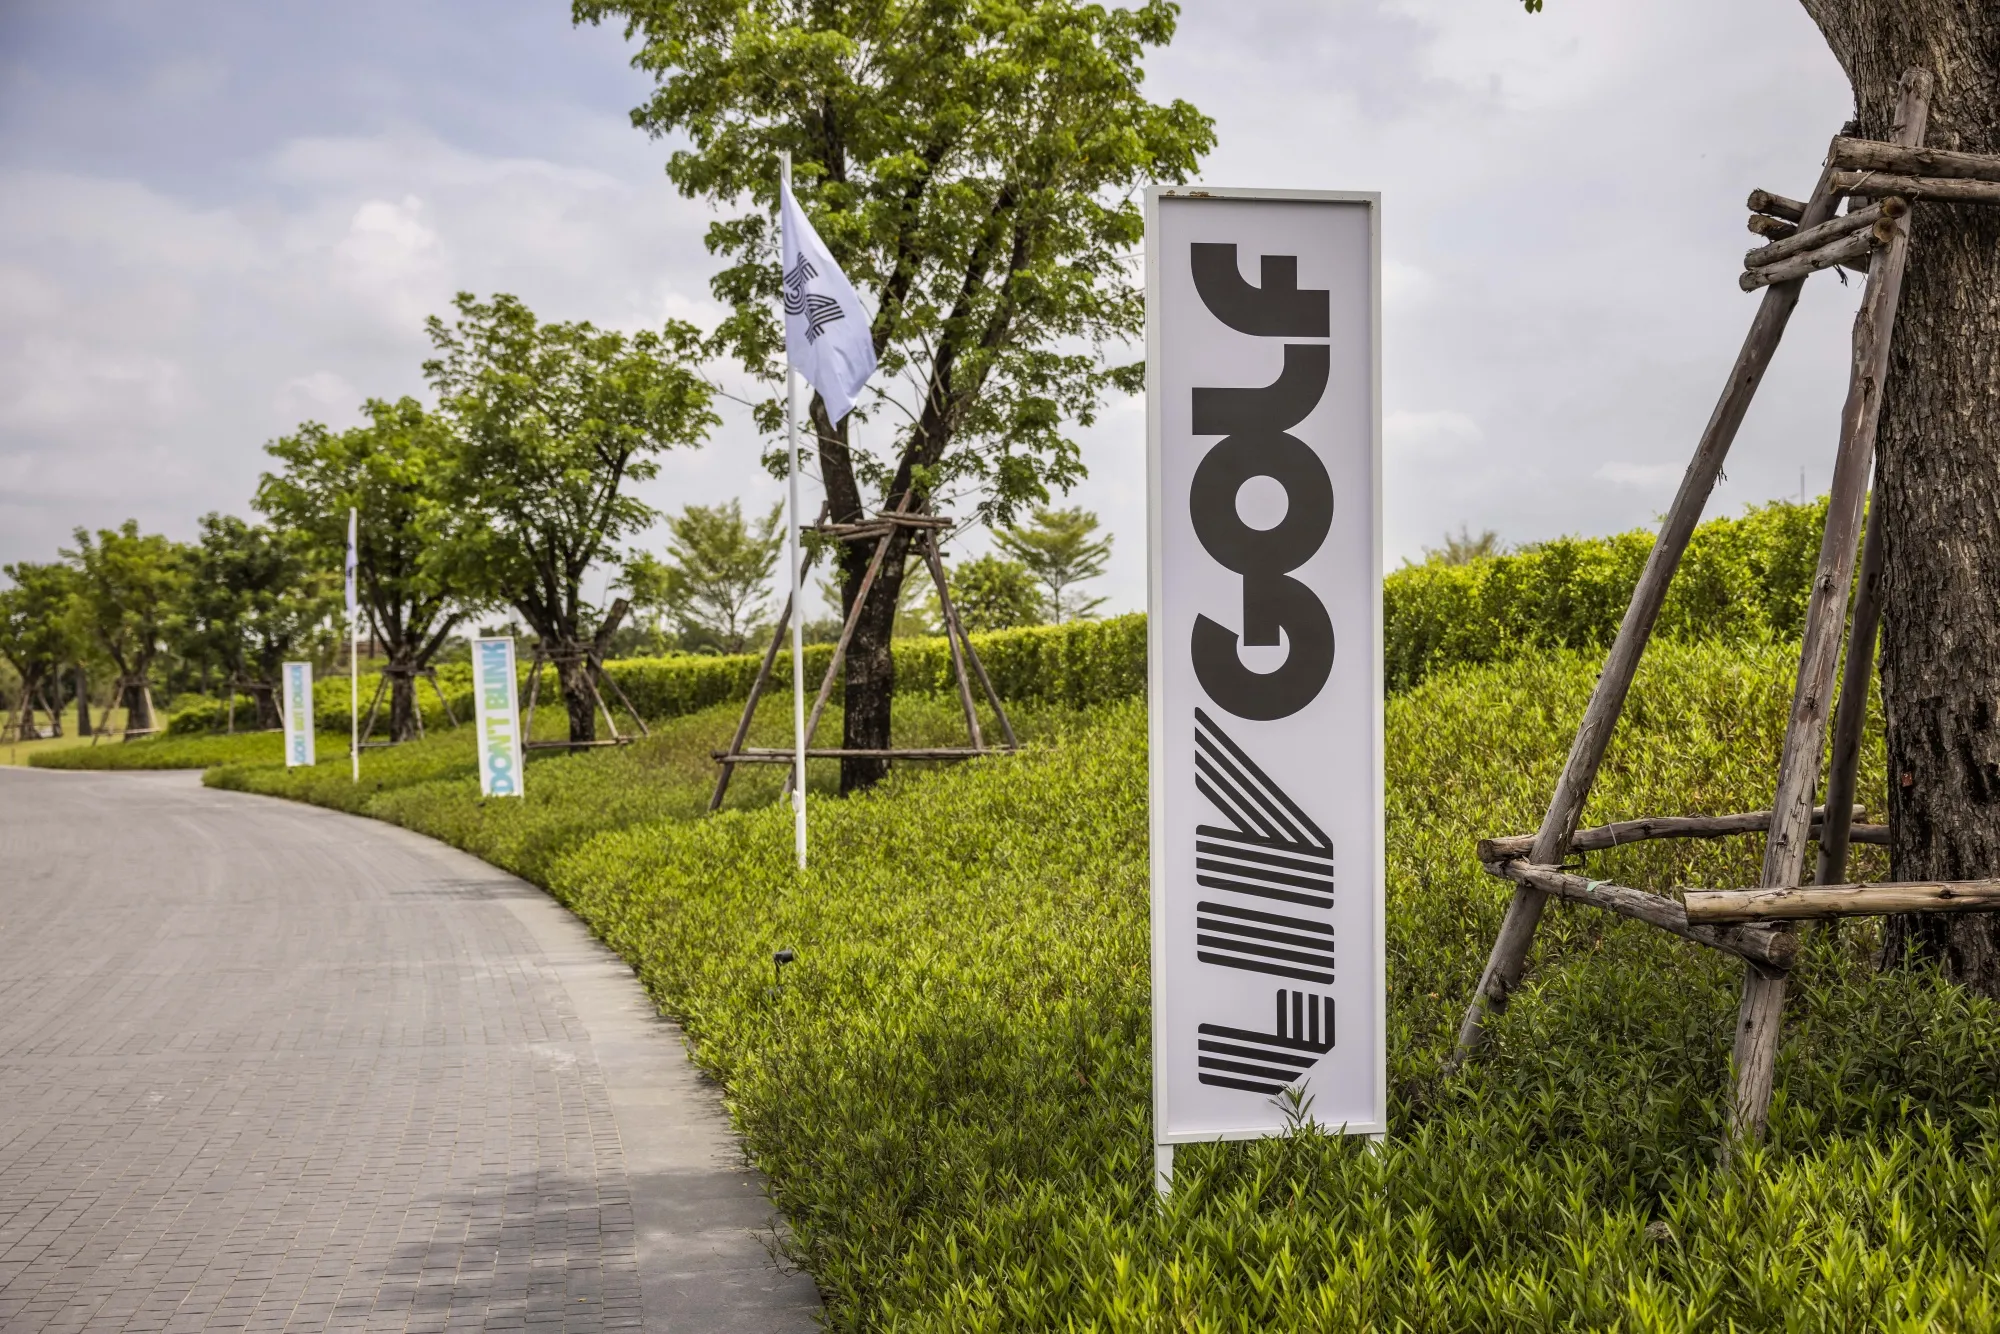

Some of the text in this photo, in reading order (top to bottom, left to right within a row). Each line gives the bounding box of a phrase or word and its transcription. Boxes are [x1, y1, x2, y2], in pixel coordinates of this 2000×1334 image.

[481, 642, 514, 793] DON'T BLINK
[1189, 242, 1336, 1095] LIV GOLF
